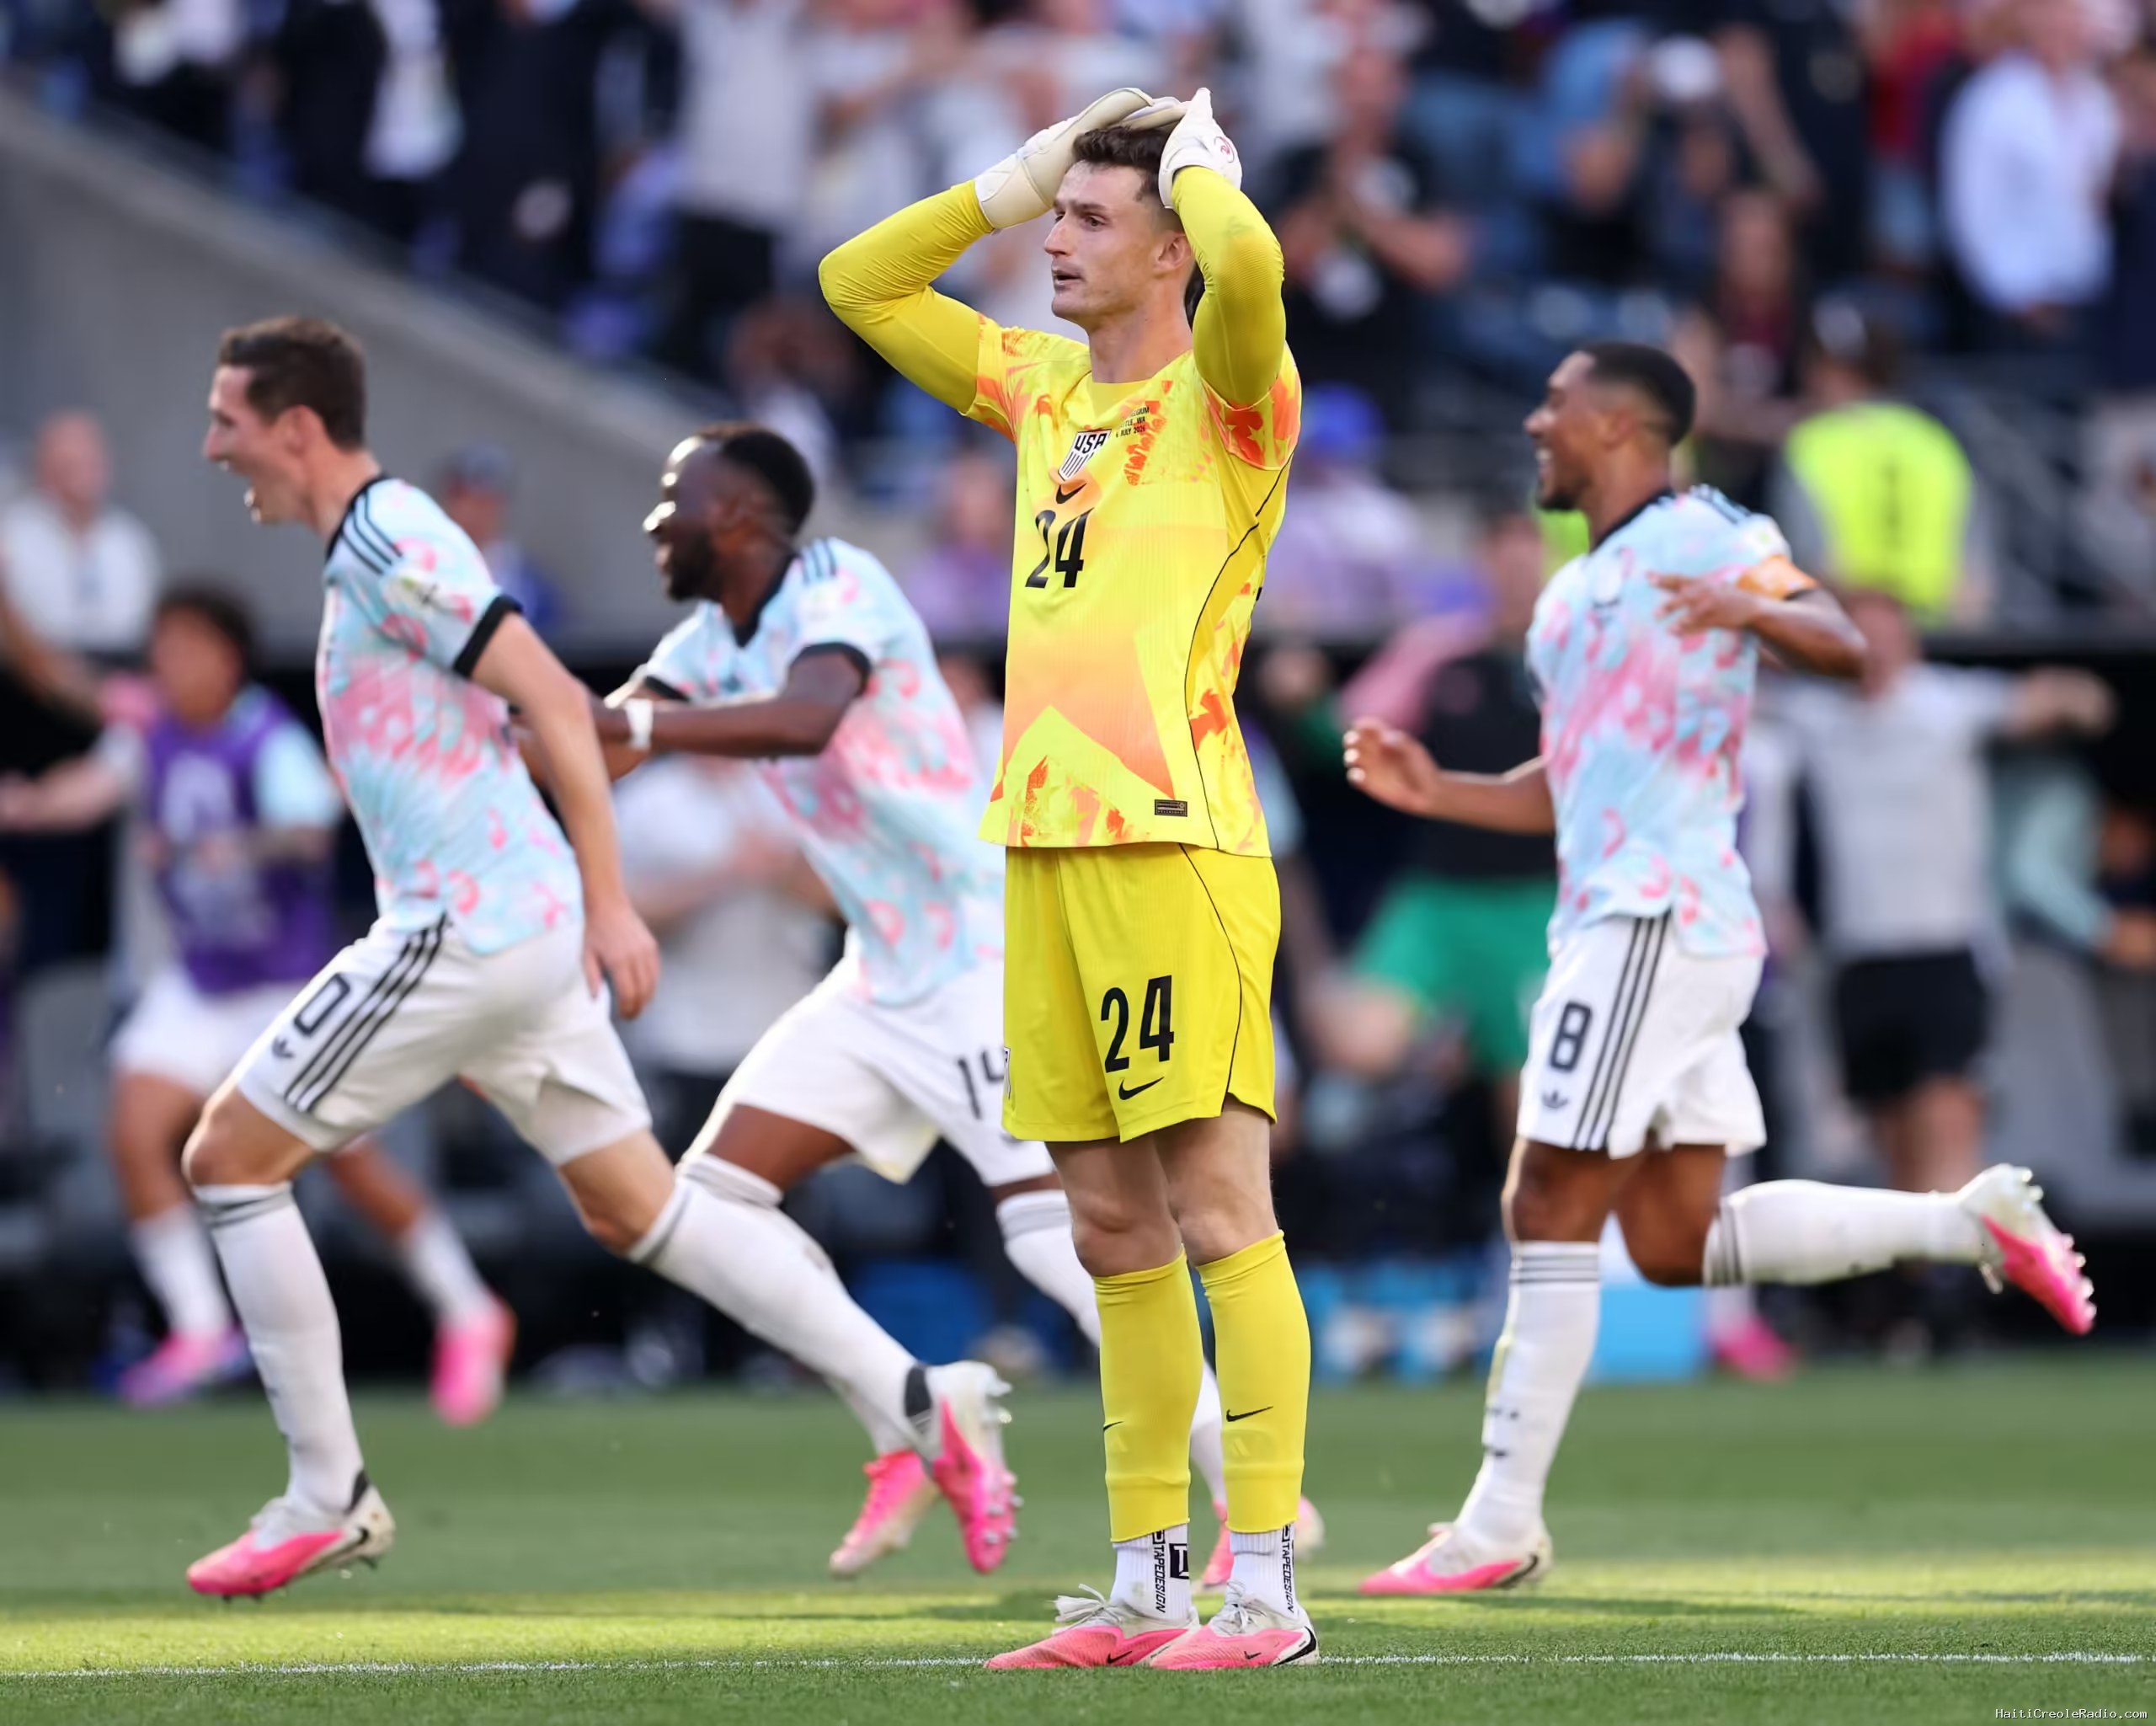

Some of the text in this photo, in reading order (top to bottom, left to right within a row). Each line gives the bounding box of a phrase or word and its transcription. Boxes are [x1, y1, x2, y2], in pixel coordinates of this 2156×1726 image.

[1075, 433, 1107, 454] USA
[1120, 427, 1132, 436] JULY
[1024, 507, 1095, 589] 24
[1100, 975, 1175, 1073] 24
[1550, 1000, 1593, 1073] 8
[1153, 1545, 1166, 1613] TAPEDESIGN
[1282, 1542, 1294, 1614] TAPEDESIGN
